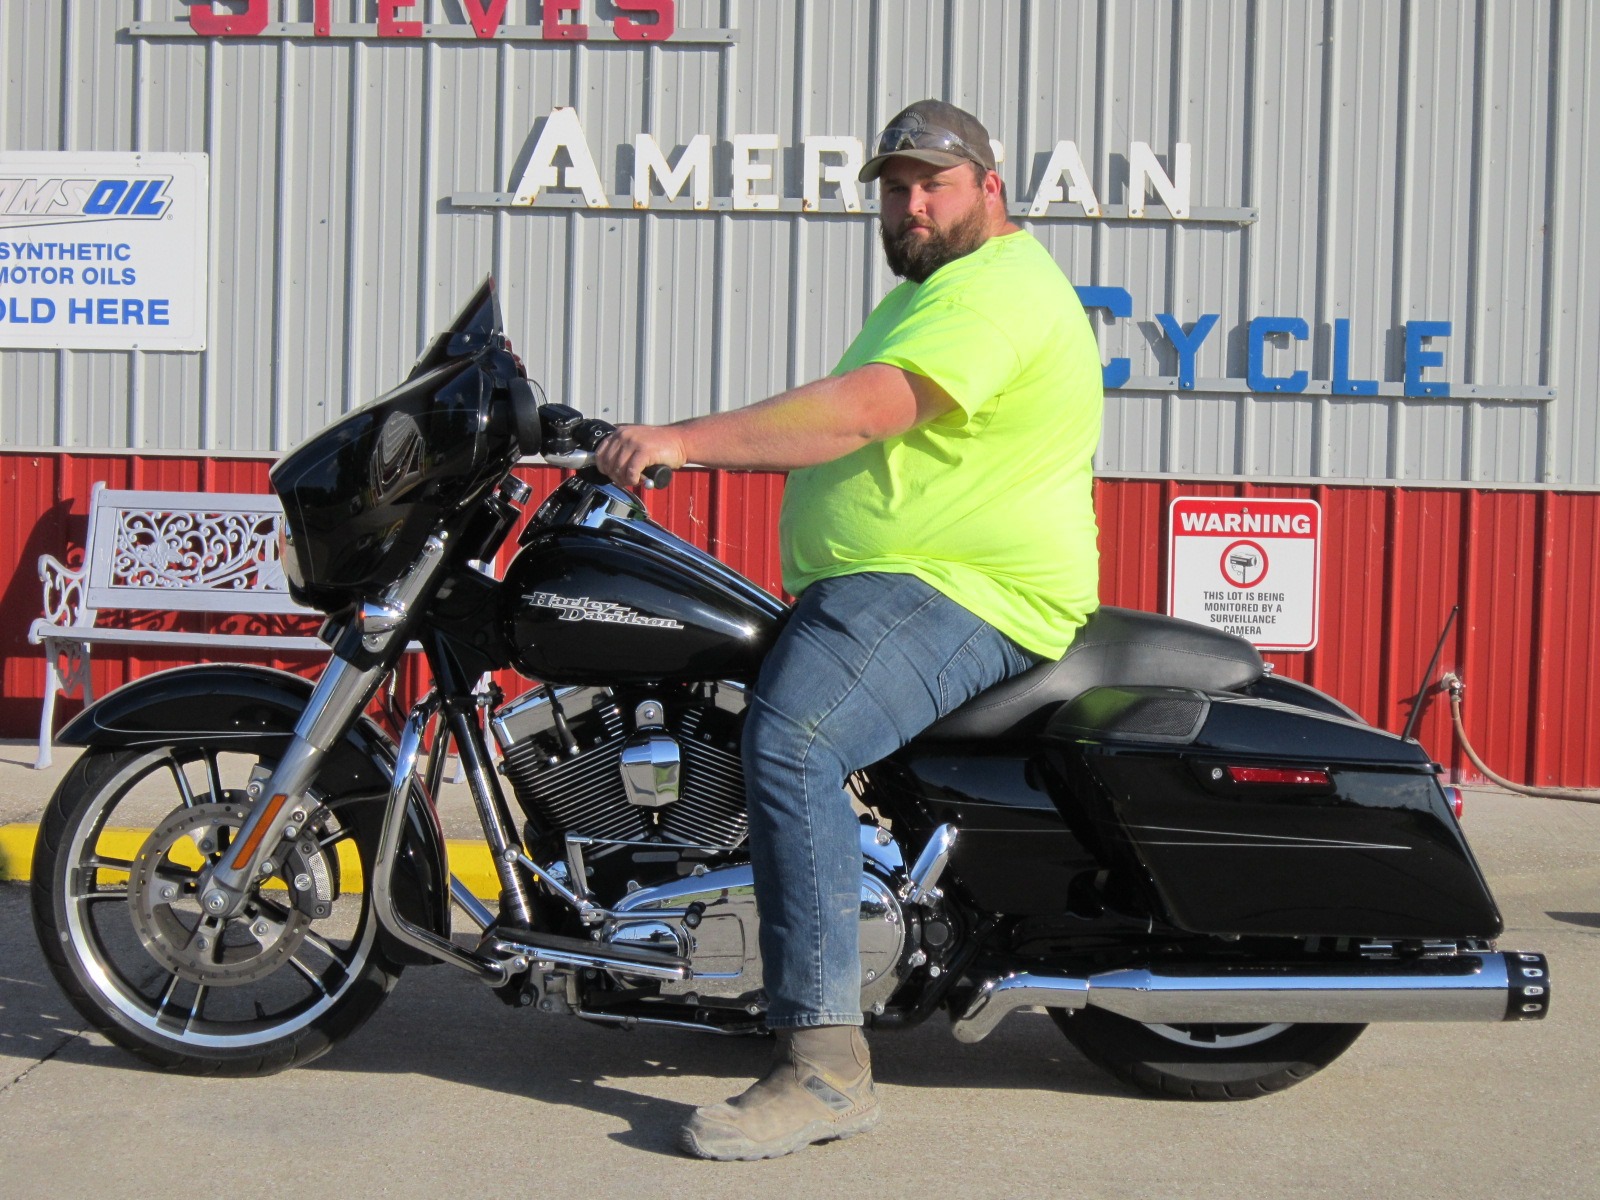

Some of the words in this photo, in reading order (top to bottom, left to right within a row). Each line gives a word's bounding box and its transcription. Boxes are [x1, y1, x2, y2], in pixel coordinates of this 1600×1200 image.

[512, 106, 1191, 219] AMERAN
[0, 242, 131, 261] SYNTHETIC
[81, 267, 136, 285] OILS
[0, 297, 56, 325] LD
[68, 298, 170, 326] HERE
[1180, 512, 1311, 534] WARNING
[1203, 591, 1224, 600] THIS
[1227, 591, 1243, 601] LOT
[1246, 592, 1255, 601] IS
[1257, 592, 1285, 602] BEING
[1204, 602, 1259, 612] MONITORED
[1261, 603, 1274, 613] BY
[1275, 604, 1282, 613] A
[552, 606, 684, 629] Davidson
[1210, 613, 1277, 624] SURVEILLANCE
[1223, 625, 1262, 635] CAMERA
